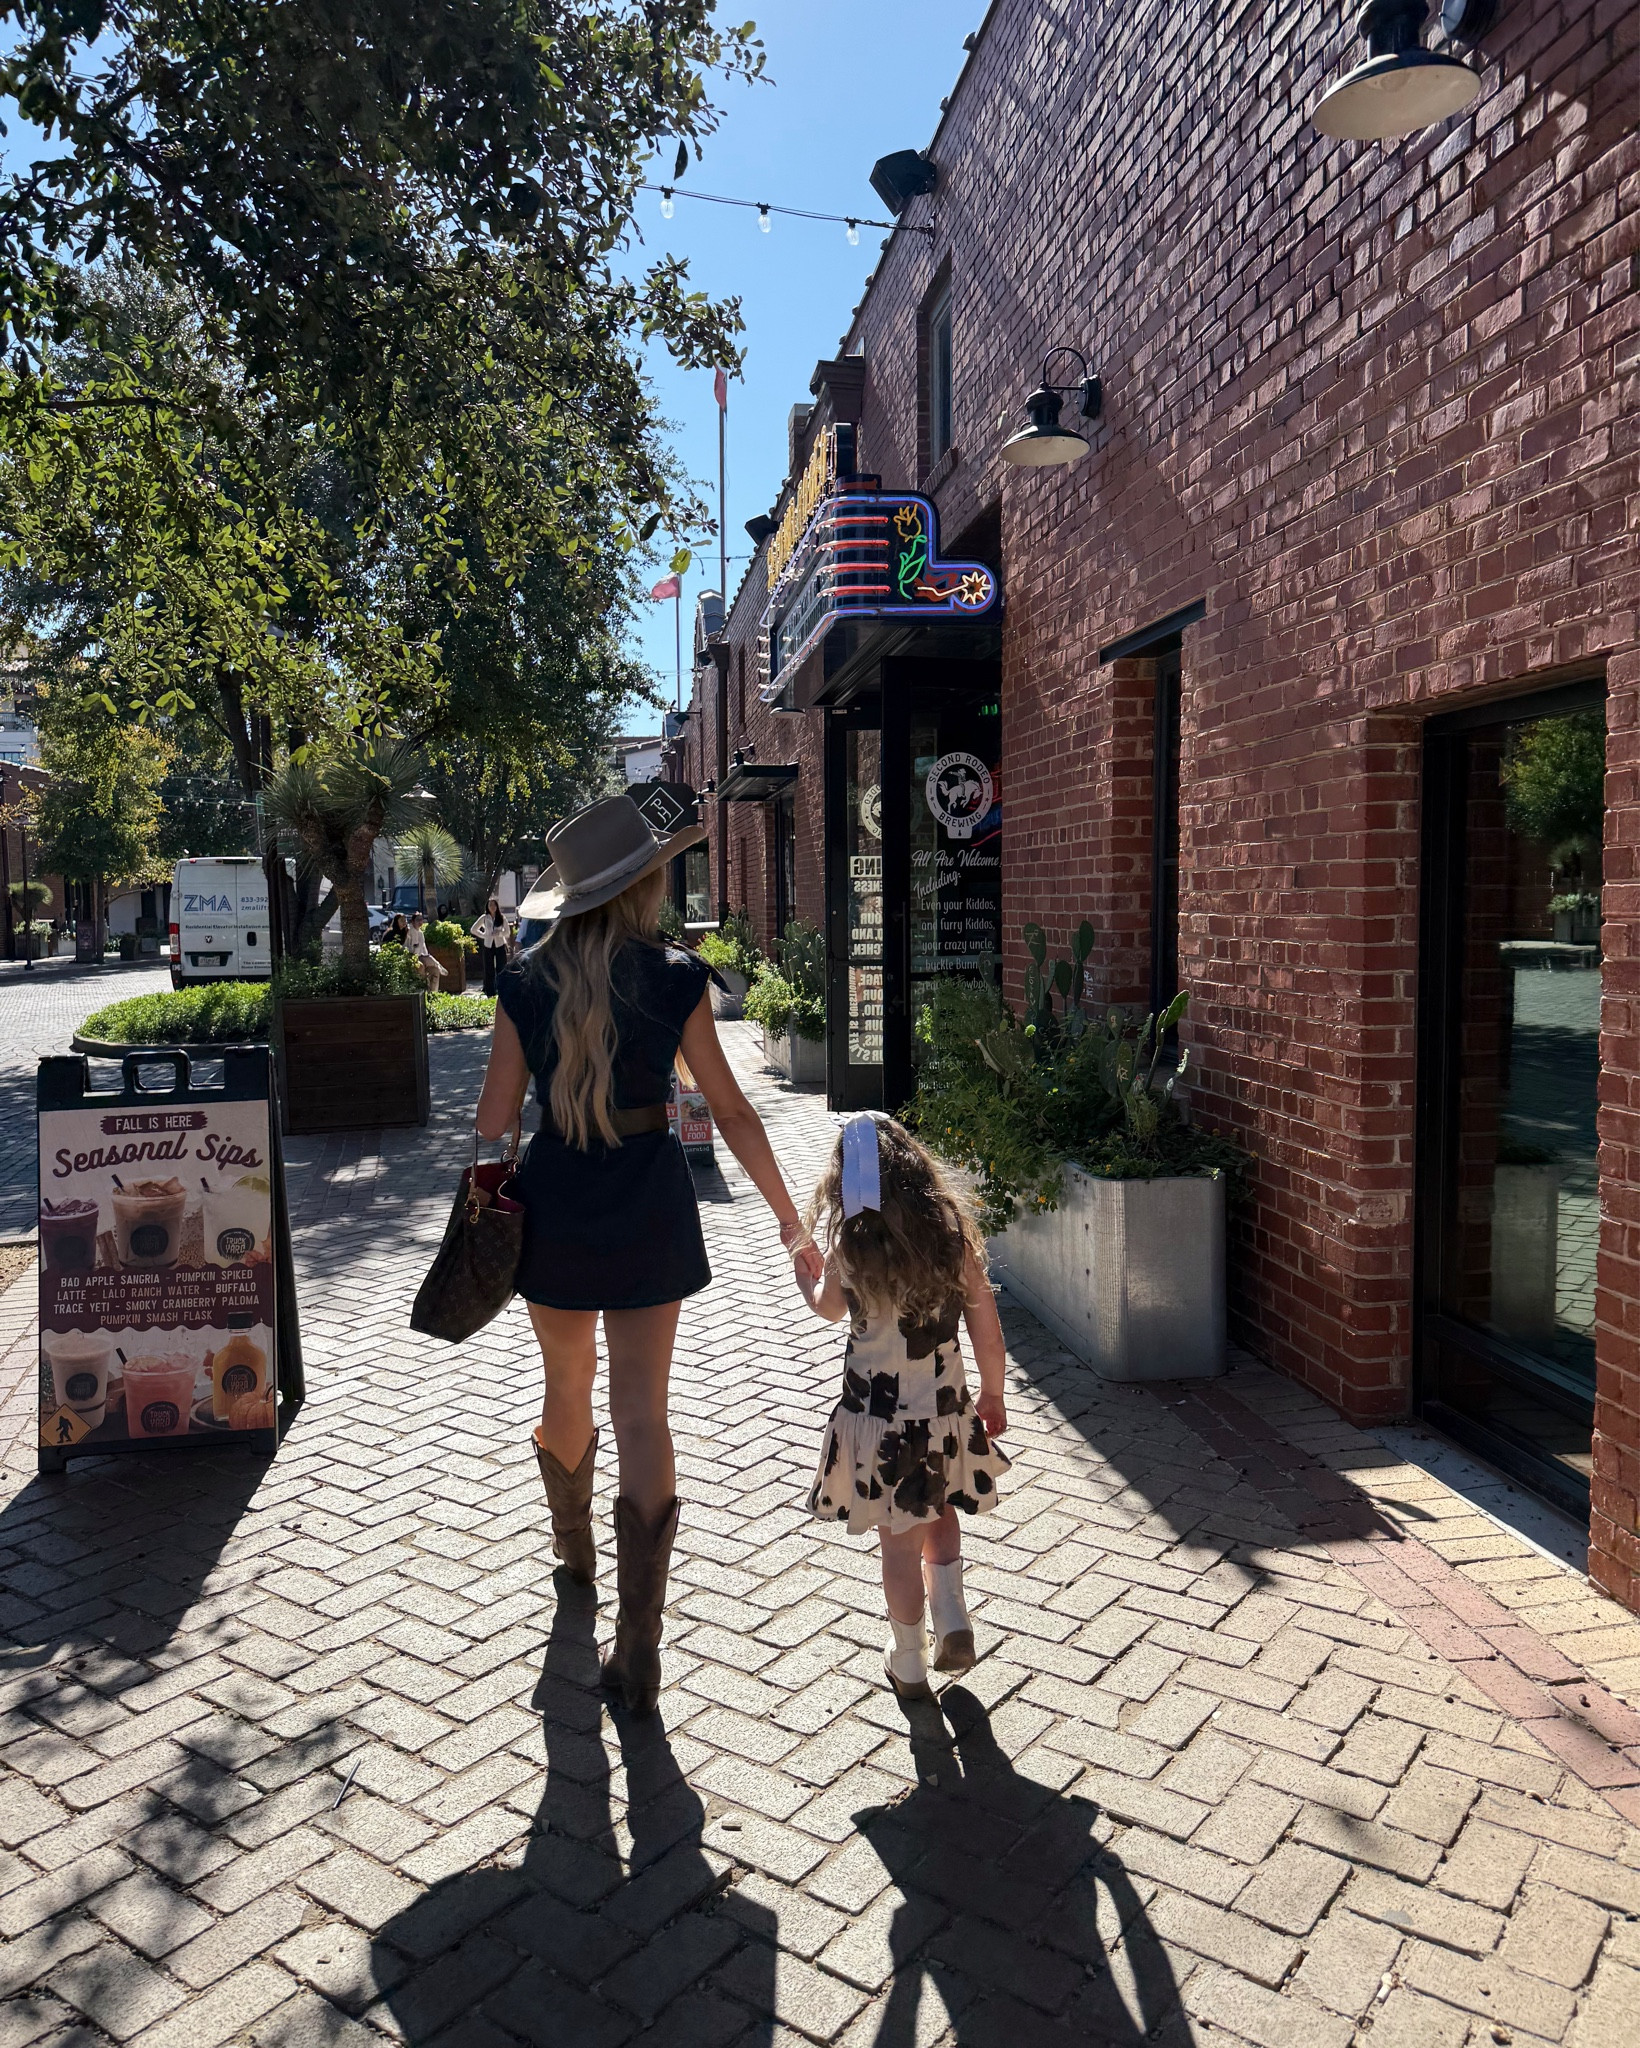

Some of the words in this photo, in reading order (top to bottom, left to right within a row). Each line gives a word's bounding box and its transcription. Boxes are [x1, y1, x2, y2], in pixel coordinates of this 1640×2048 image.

[929, 753, 961, 783] SECOND
[965, 755, 990, 784] RODEO
[938, 811, 982, 828] BREWING
[911, 849, 932, 867] All
[933, 849, 955, 867] Are
[913, 870, 962, 899] Including:
[184, 894, 233, 912] ZMA
[921, 898, 941, 911] Even
[943, 901, 963, 914] your
[965, 897, 996, 911] Kiddos,
[921, 918, 938, 931] and
[940, 917, 963, 934] furry
[965, 917, 996, 931] Kiddos,
[921, 941, 941, 955] your
[944, 940, 967, 954] crazy
[969, 937, 995, 950] uncle,
[955, 957, 978, 970] Bunn
[115, 1117, 143, 1131] FALL
[149, 1116, 159, 1129] IS
[165, 1114, 193, 1128] HERE
[683, 1123, 709, 1131] TASTY
[687, 1132, 706, 1140] FOOD
[52, 1132, 188, 1178] Seasonal
[196, 1133, 264, 1171] Sips
[60, 1276, 80, 1288] BAD
[85, 1275, 115, 1287] APPLE
[120, 1273, 160, 1285] SANGRIA
[175, 1271, 216, 1283] PUMPKIN
[221, 1269, 253, 1280] SPIKED
[57, 1289, 87, 1301] LATTE
[102, 1288, 126, 1299] LALO
[131, 1286, 162, 1298] RANCH
[167, 1284, 200, 1296] WATER
[215, 1281, 257, 1294] BUFFALO
[53, 1303, 84, 1314] TRACE
[89, 1302, 110, 1313] YETI
[125, 1299, 157, 1311] SMOKY
[162, 1296, 217, 1309] CRANBERRY
[221, 1294, 260, 1306] PALOMA
[100, 1313, 141, 1326] PUMPKIN
[146, 1311, 179, 1323] SMASH
[183, 1310, 213, 1321] FLASK
